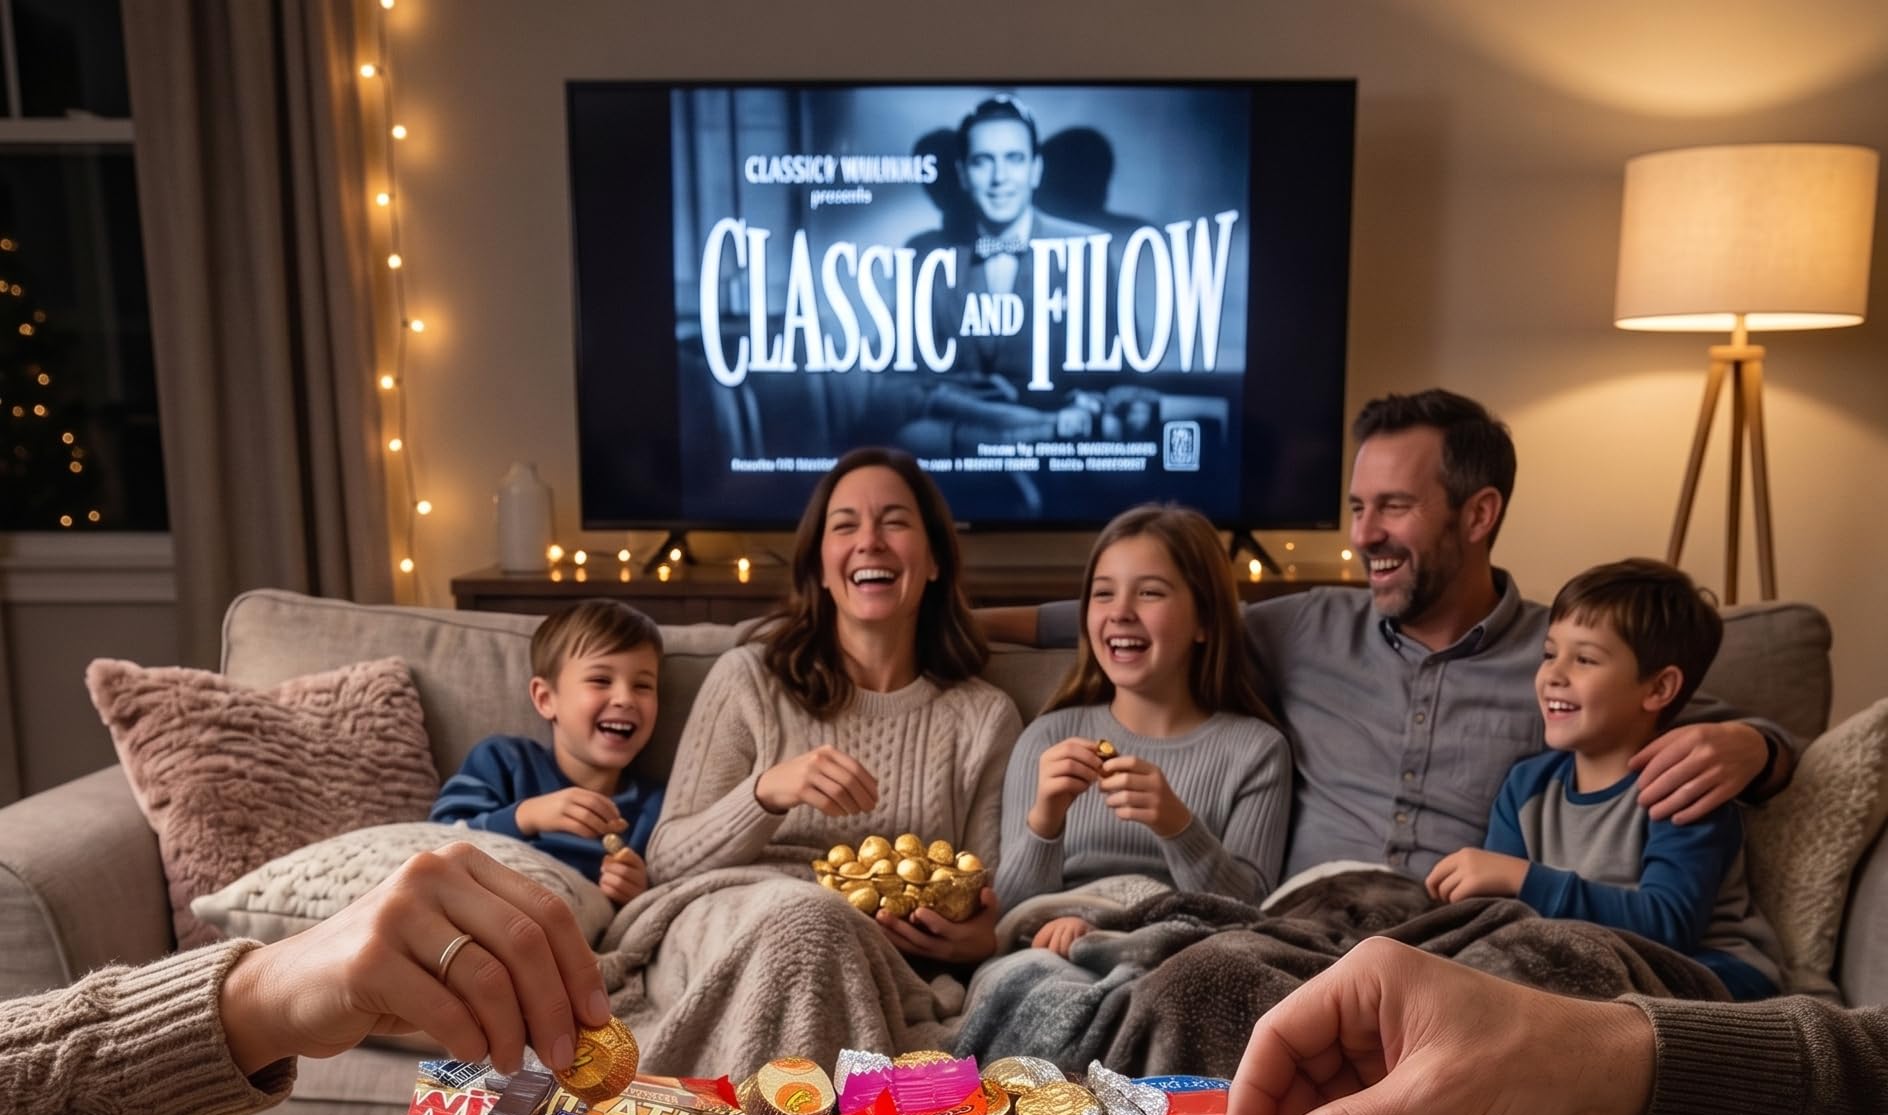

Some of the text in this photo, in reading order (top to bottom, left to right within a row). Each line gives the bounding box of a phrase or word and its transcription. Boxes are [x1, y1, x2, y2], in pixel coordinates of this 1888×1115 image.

[700, 209, 1240, 391] CLASSIC AND FILOW
